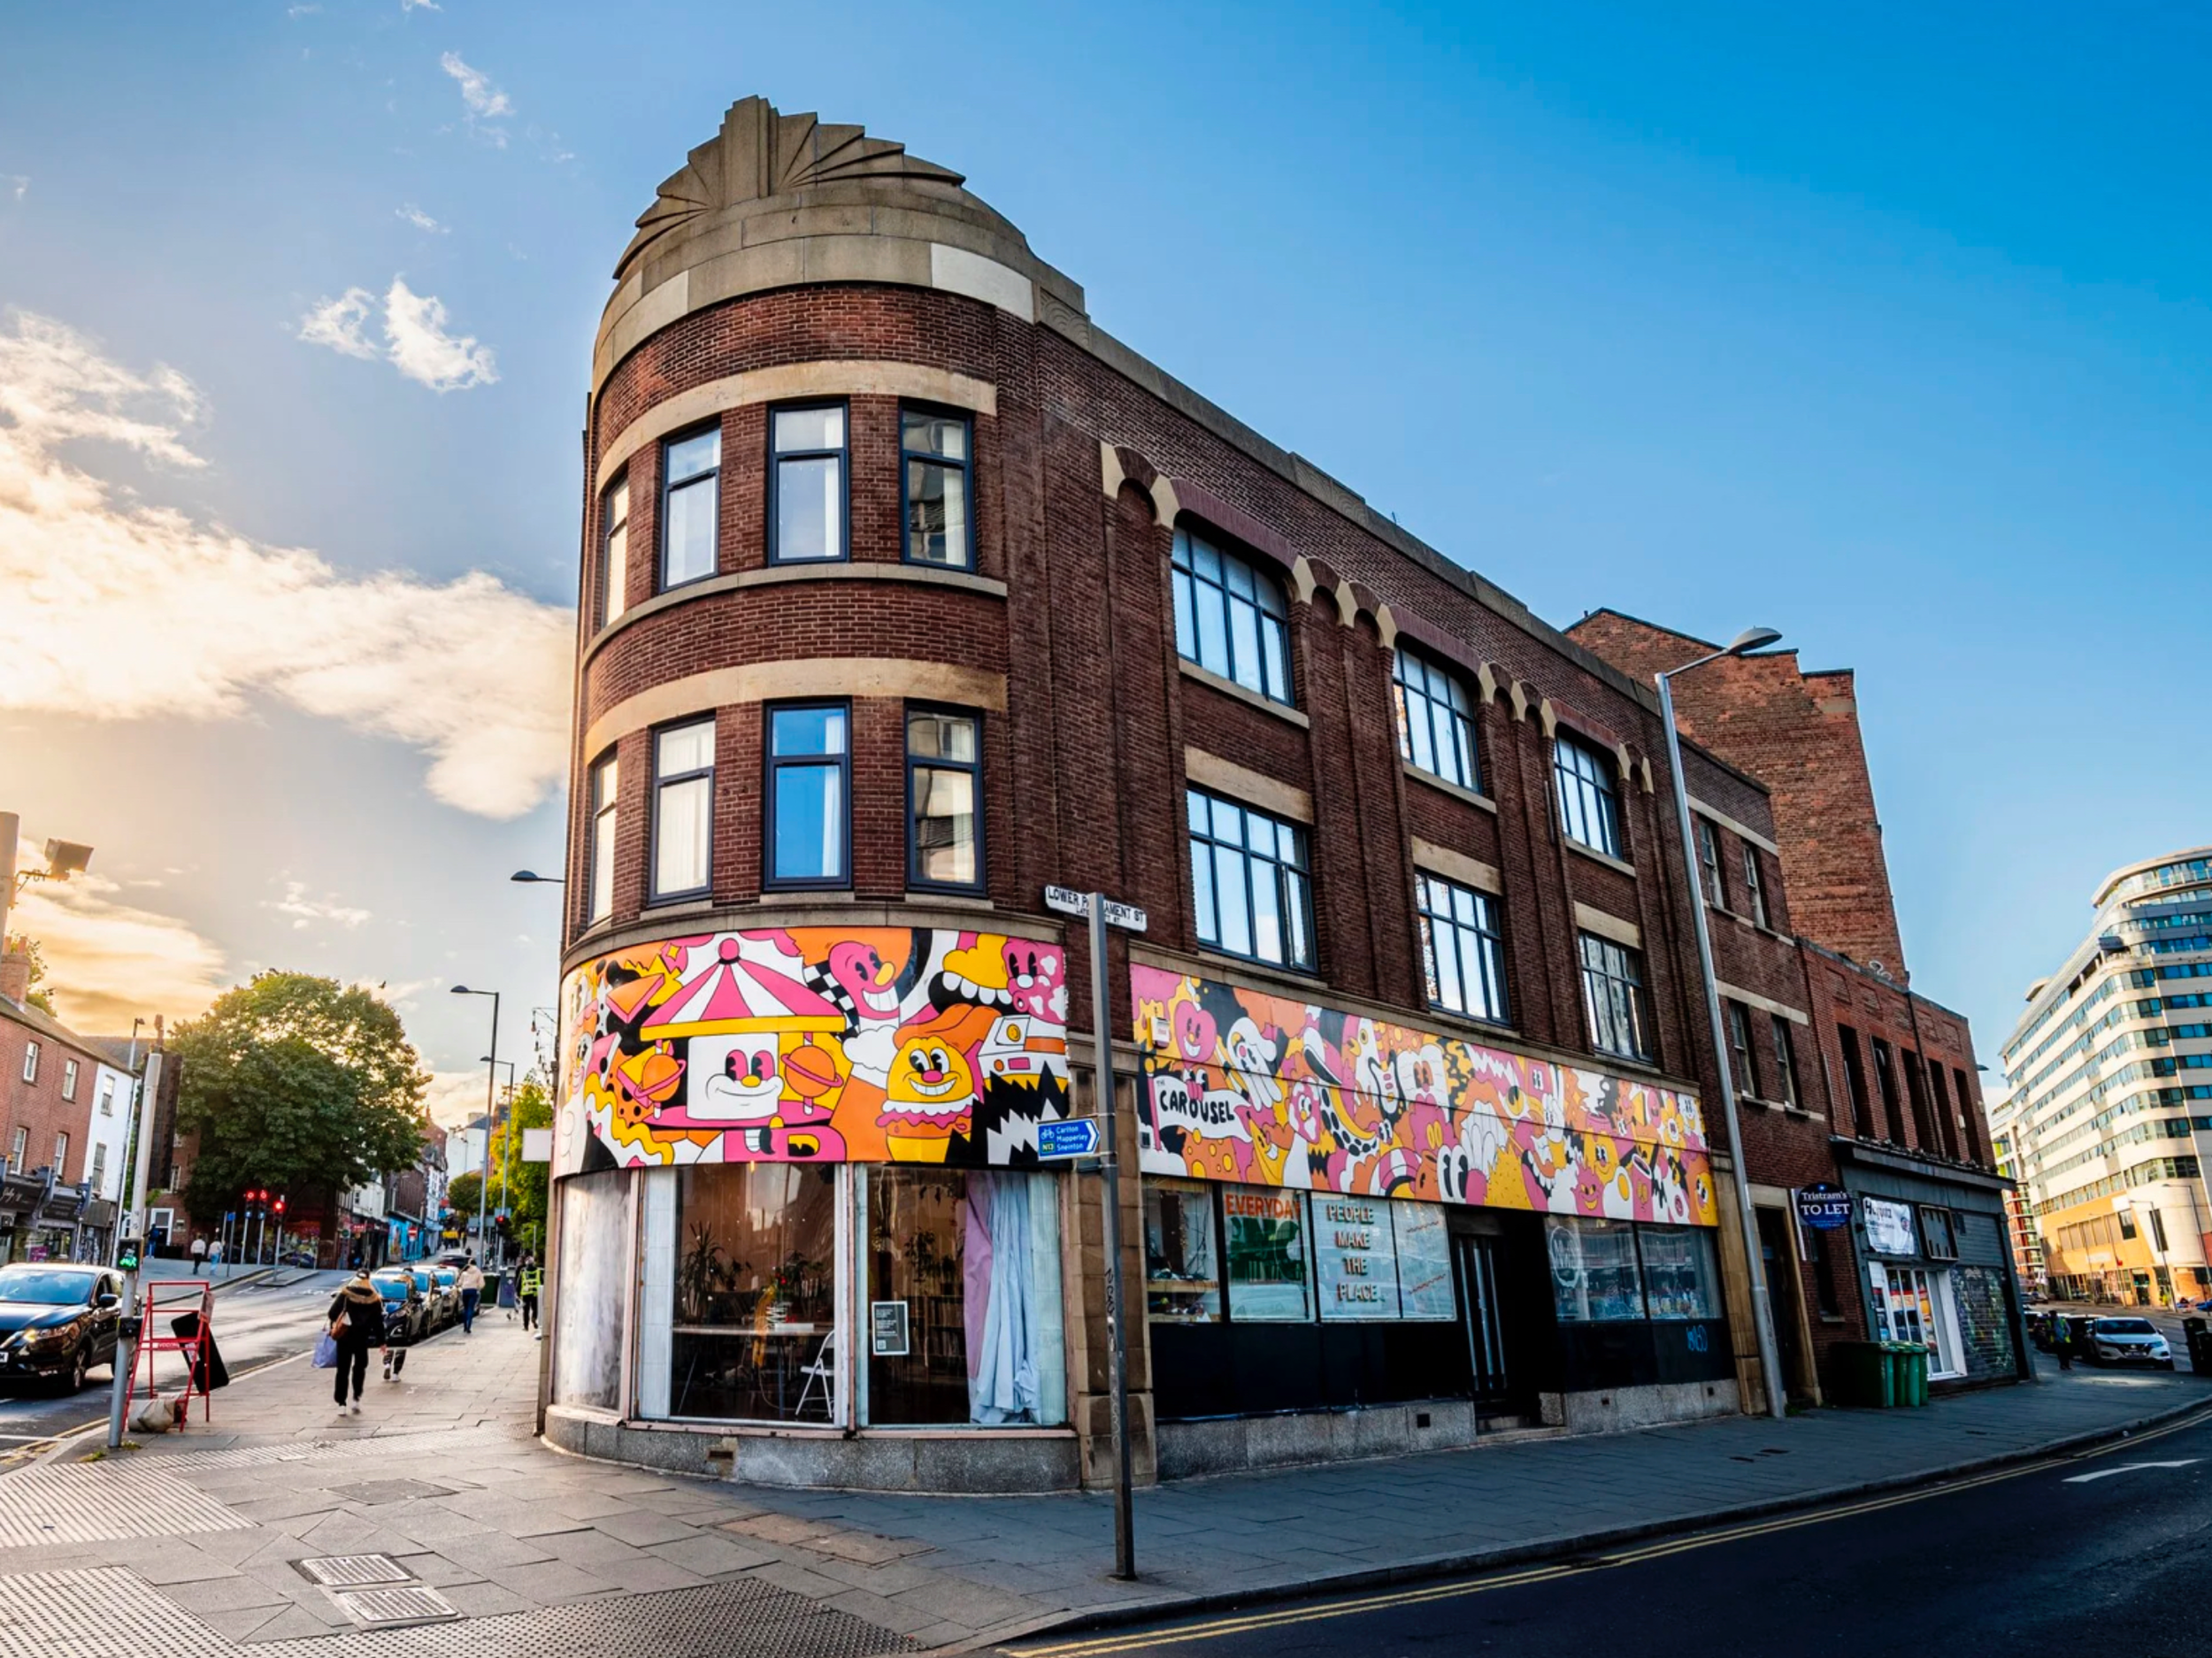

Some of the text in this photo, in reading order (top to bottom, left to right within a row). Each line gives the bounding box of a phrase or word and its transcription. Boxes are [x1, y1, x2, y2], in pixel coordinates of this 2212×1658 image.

[1048, 887, 1079, 905] LOWER
[1082, 896, 1131, 920] PAMENT
[1133, 910, 1144, 923] ST
[1160, 1089, 1235, 1125] CAROUSEL
[1056, 1134, 1088, 1143] Mapperley
[1801, 1191, 1847, 1201] Tristram's
[1326, 1204, 1374, 1224] PEOPLE
[1801, 1203, 1850, 1216] TO LET
[1335, 1231, 1371, 1249] MAKE
[1342, 1257, 1368, 1276] THE
